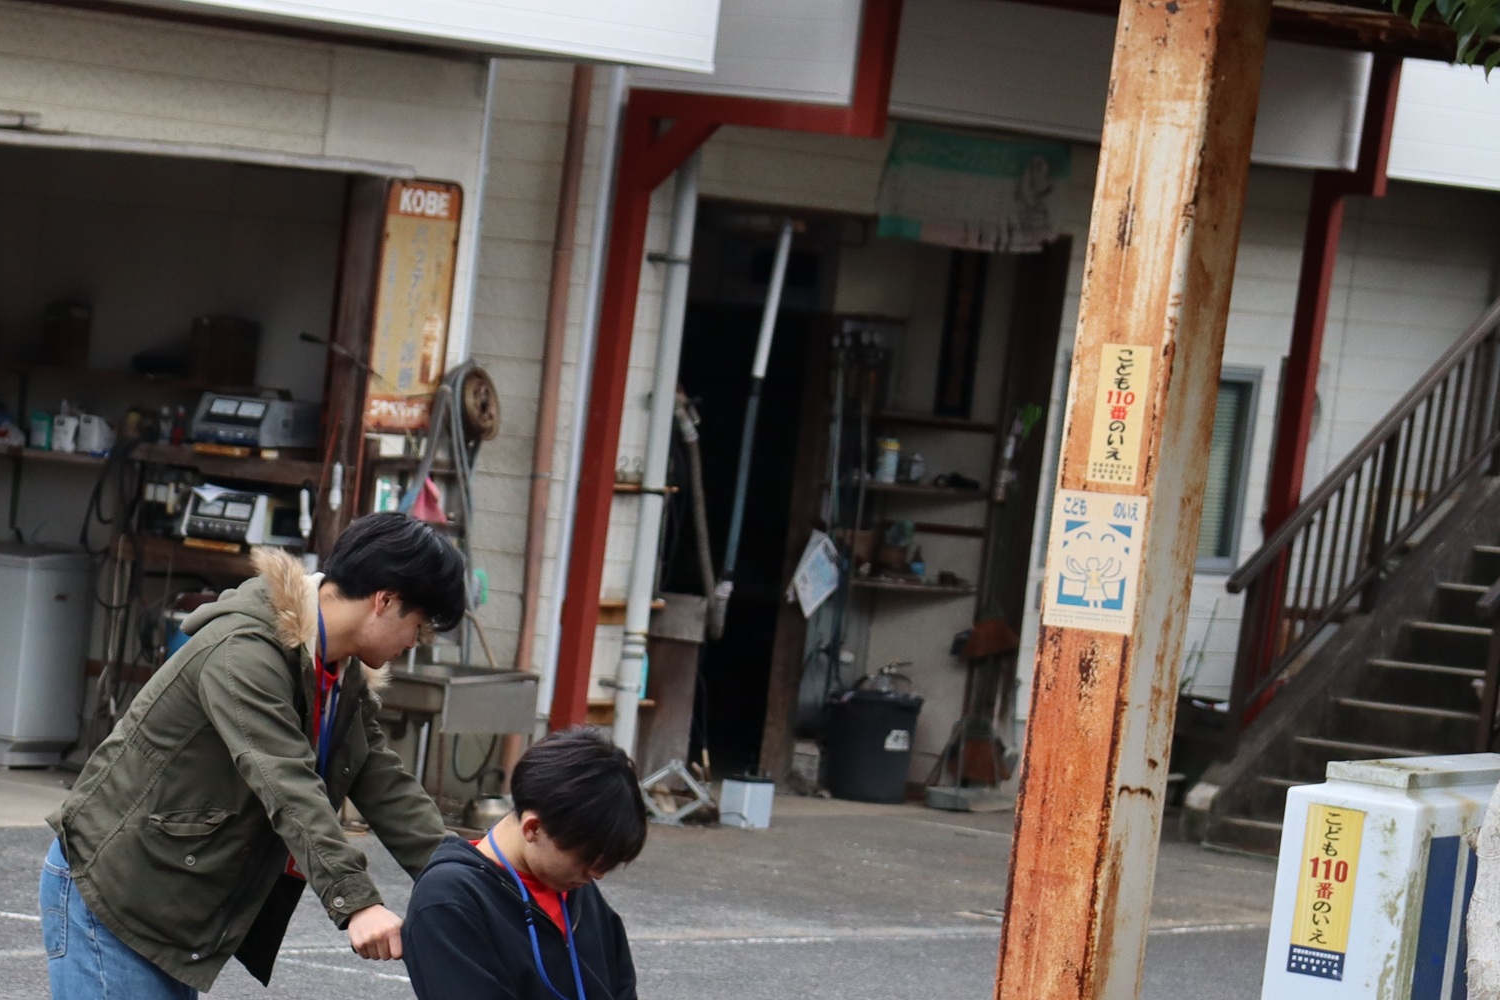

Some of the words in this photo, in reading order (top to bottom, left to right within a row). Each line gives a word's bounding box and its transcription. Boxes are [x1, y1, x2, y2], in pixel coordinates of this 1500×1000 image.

[399, 188, 451, 216] KOBE
[1105, 349, 1136, 461] こども110番のいえ
[1063, 496, 1087, 515] こども
[1113, 501, 1139, 521] のいえ
[1308, 812, 1349, 944] こども110番のいえ
